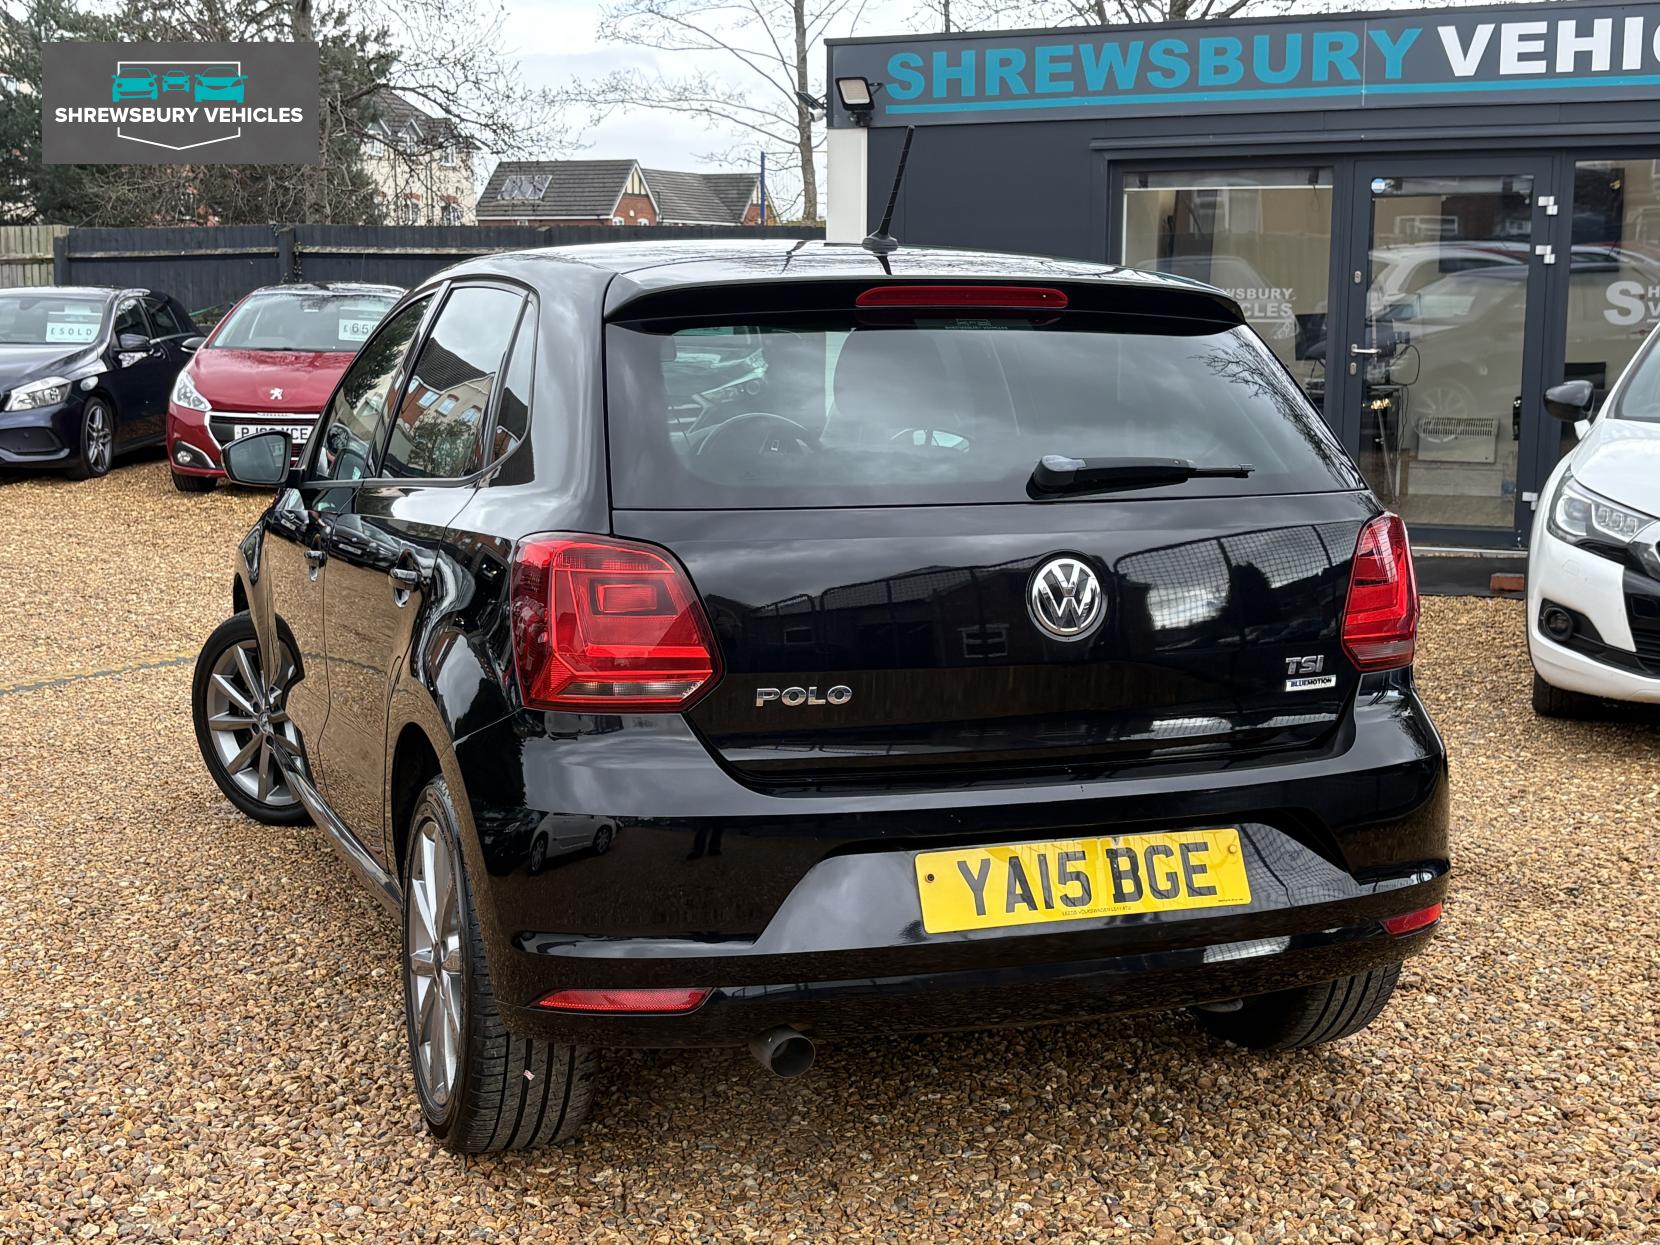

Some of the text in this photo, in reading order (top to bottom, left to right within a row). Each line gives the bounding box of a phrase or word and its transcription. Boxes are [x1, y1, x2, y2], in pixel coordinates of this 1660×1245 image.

[886, 16, 1660, 100] SHREWSBURY VEHI
[1285, 655, 1324, 675] TSI
[756, 685, 852, 707] POLO
[957, 841, 1218, 916] YA15 BGE
